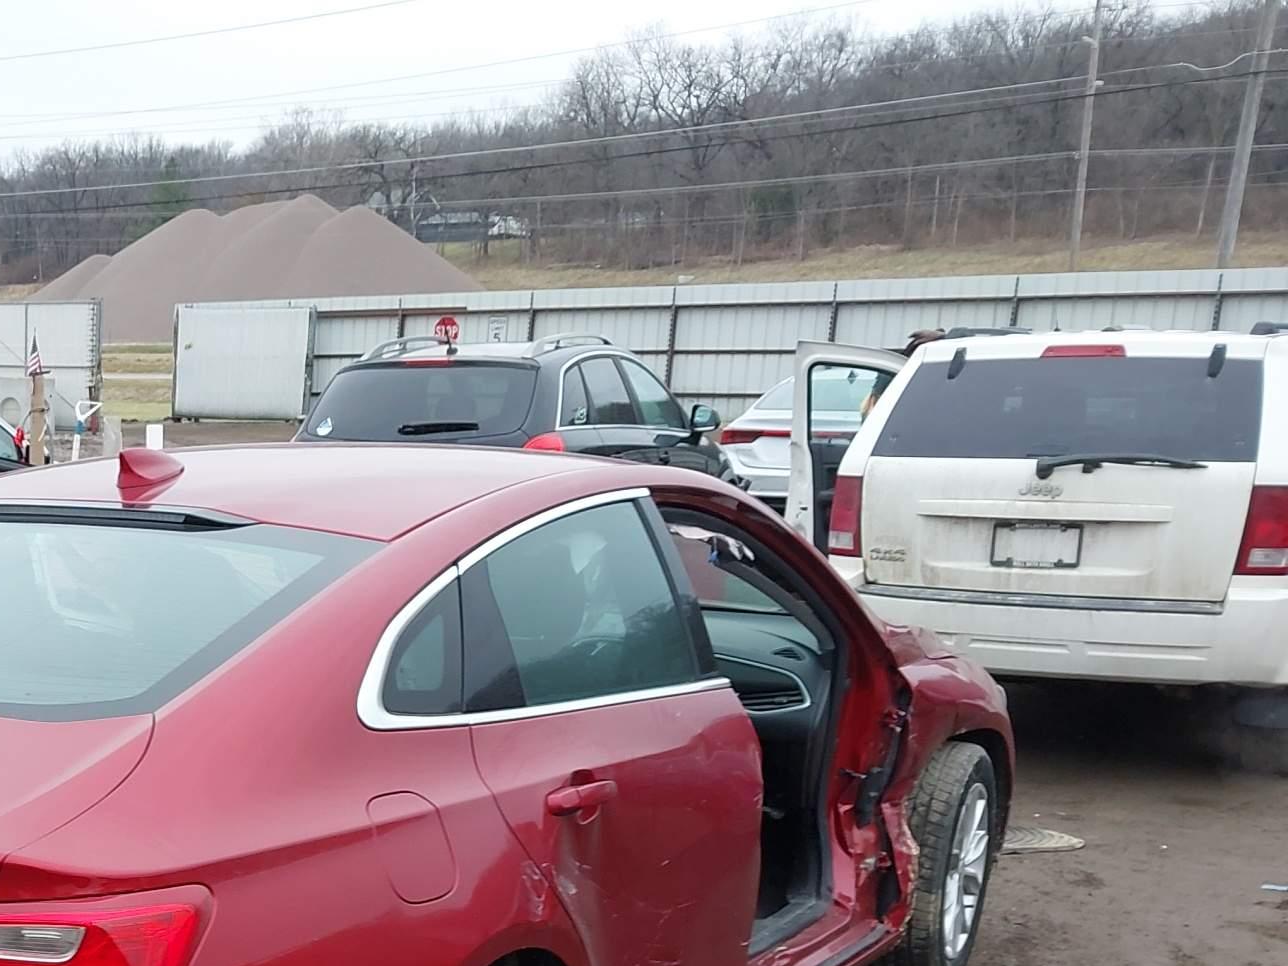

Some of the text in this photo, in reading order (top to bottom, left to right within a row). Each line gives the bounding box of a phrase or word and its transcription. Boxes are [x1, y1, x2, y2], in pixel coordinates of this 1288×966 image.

[435, 325, 458, 338] STOP
[493, 332, 501, 342] 5
[1018, 479, 1064, 499] Jeep
